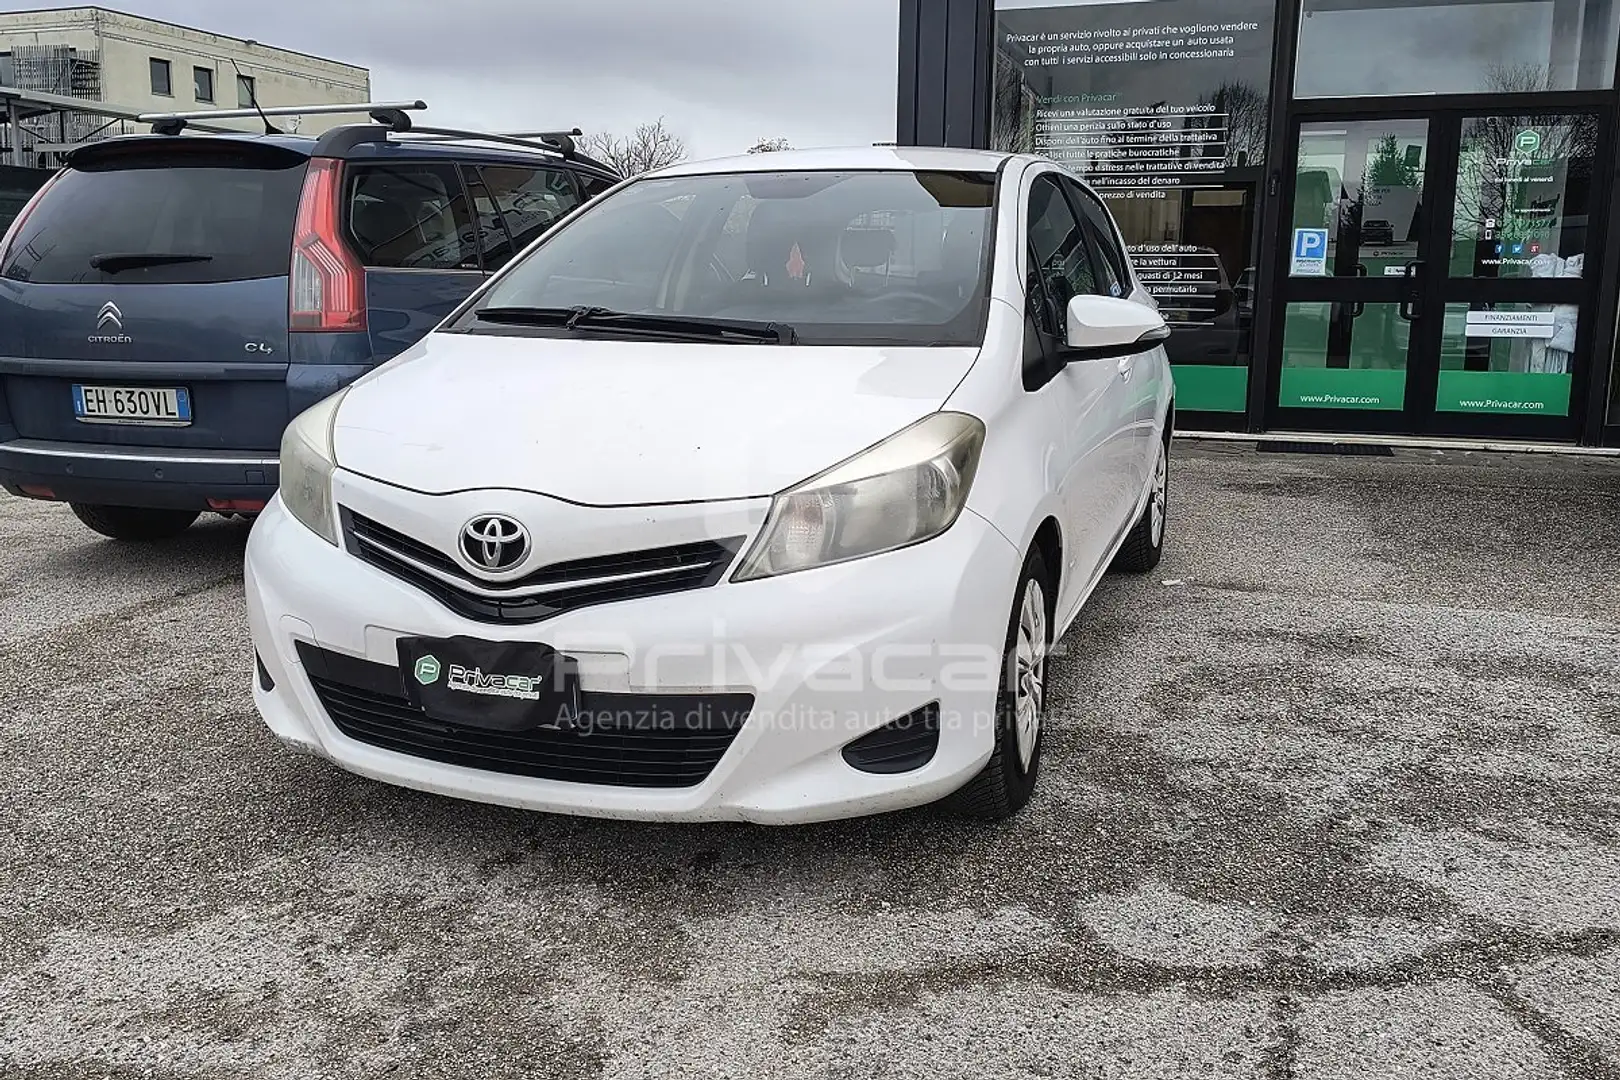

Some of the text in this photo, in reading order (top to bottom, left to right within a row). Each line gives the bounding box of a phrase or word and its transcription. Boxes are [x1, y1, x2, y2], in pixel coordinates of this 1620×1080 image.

[1006, 34, 1039, 42] Privacar
[1060, 30, 1092, 40] servizio
[1094, 28, 1121, 38] rivolto
[1122, 27, 1131, 36] ai
[1132, 26, 1160, 38] privati
[1162, 25, 1178, 35] che
[1180, 24, 1218, 35] vogliono
[1220, 22, 1258, 31] vendere
[1028, 45, 1036, 54] la
[1038, 44, 1068, 55] propria
[1092, 42, 1124, 53] oppure
[1126, 40, 1170, 50] acquistare
[1187, 37, 1207, 46] auto
[1210, 36, 1234, 45] usata
[1067, 54, 1093, 64] servizi
[1094, 52, 1138, 63] accessibili
[1140, 51, 1157, 61] solo
[1160, 51, 1167, 60] in
[1169, 48, 1234, 59] concessionaria
[1082, 94, 1116, 102] Privacar
[1076, 108, 1121, 116] valutazione
[1123, 107, 1154, 116] gratuita
[1156, 105, 1169, 114] del
[1186, 103, 1216, 112] veicolo
[1080, 122, 1106, 132] perizia
[1106, 121, 1125, 130] sullo
[1127, 121, 1147, 129] stato
[1149, 120, 1171, 128] d'uso
[1126, 134, 1157, 143] termine
[1159, 133, 1178, 142] della
[1181, 132, 1217, 141] trattativa
[1095, 149, 1127, 159] pratiche
[1128, 148, 1180, 156] burocratiche
[1125, 162, 1144, 171] nelle
[1146, 161, 1182, 170] trattative
[1184, 161, 1191, 169] di
[1194, 160, 1225, 169] vendita
[1091, 176, 1136, 185] nell'incasso
[1137, 176, 1150, 184] del
[1152, 176, 1180, 184] denaro
[1138, 244, 1159, 252] d'uso
[1301, 232, 1320, 256] P
[1137, 272, 1161, 280] guasti
[244, 342, 272, 354] C4
[84, 388, 177, 416] EH 630VL
[1300, 394, 1380, 404] www.Privacar.com
[1460, 400, 1544, 409] www.Privacar.com
[449, 664, 542, 691] Privacar
